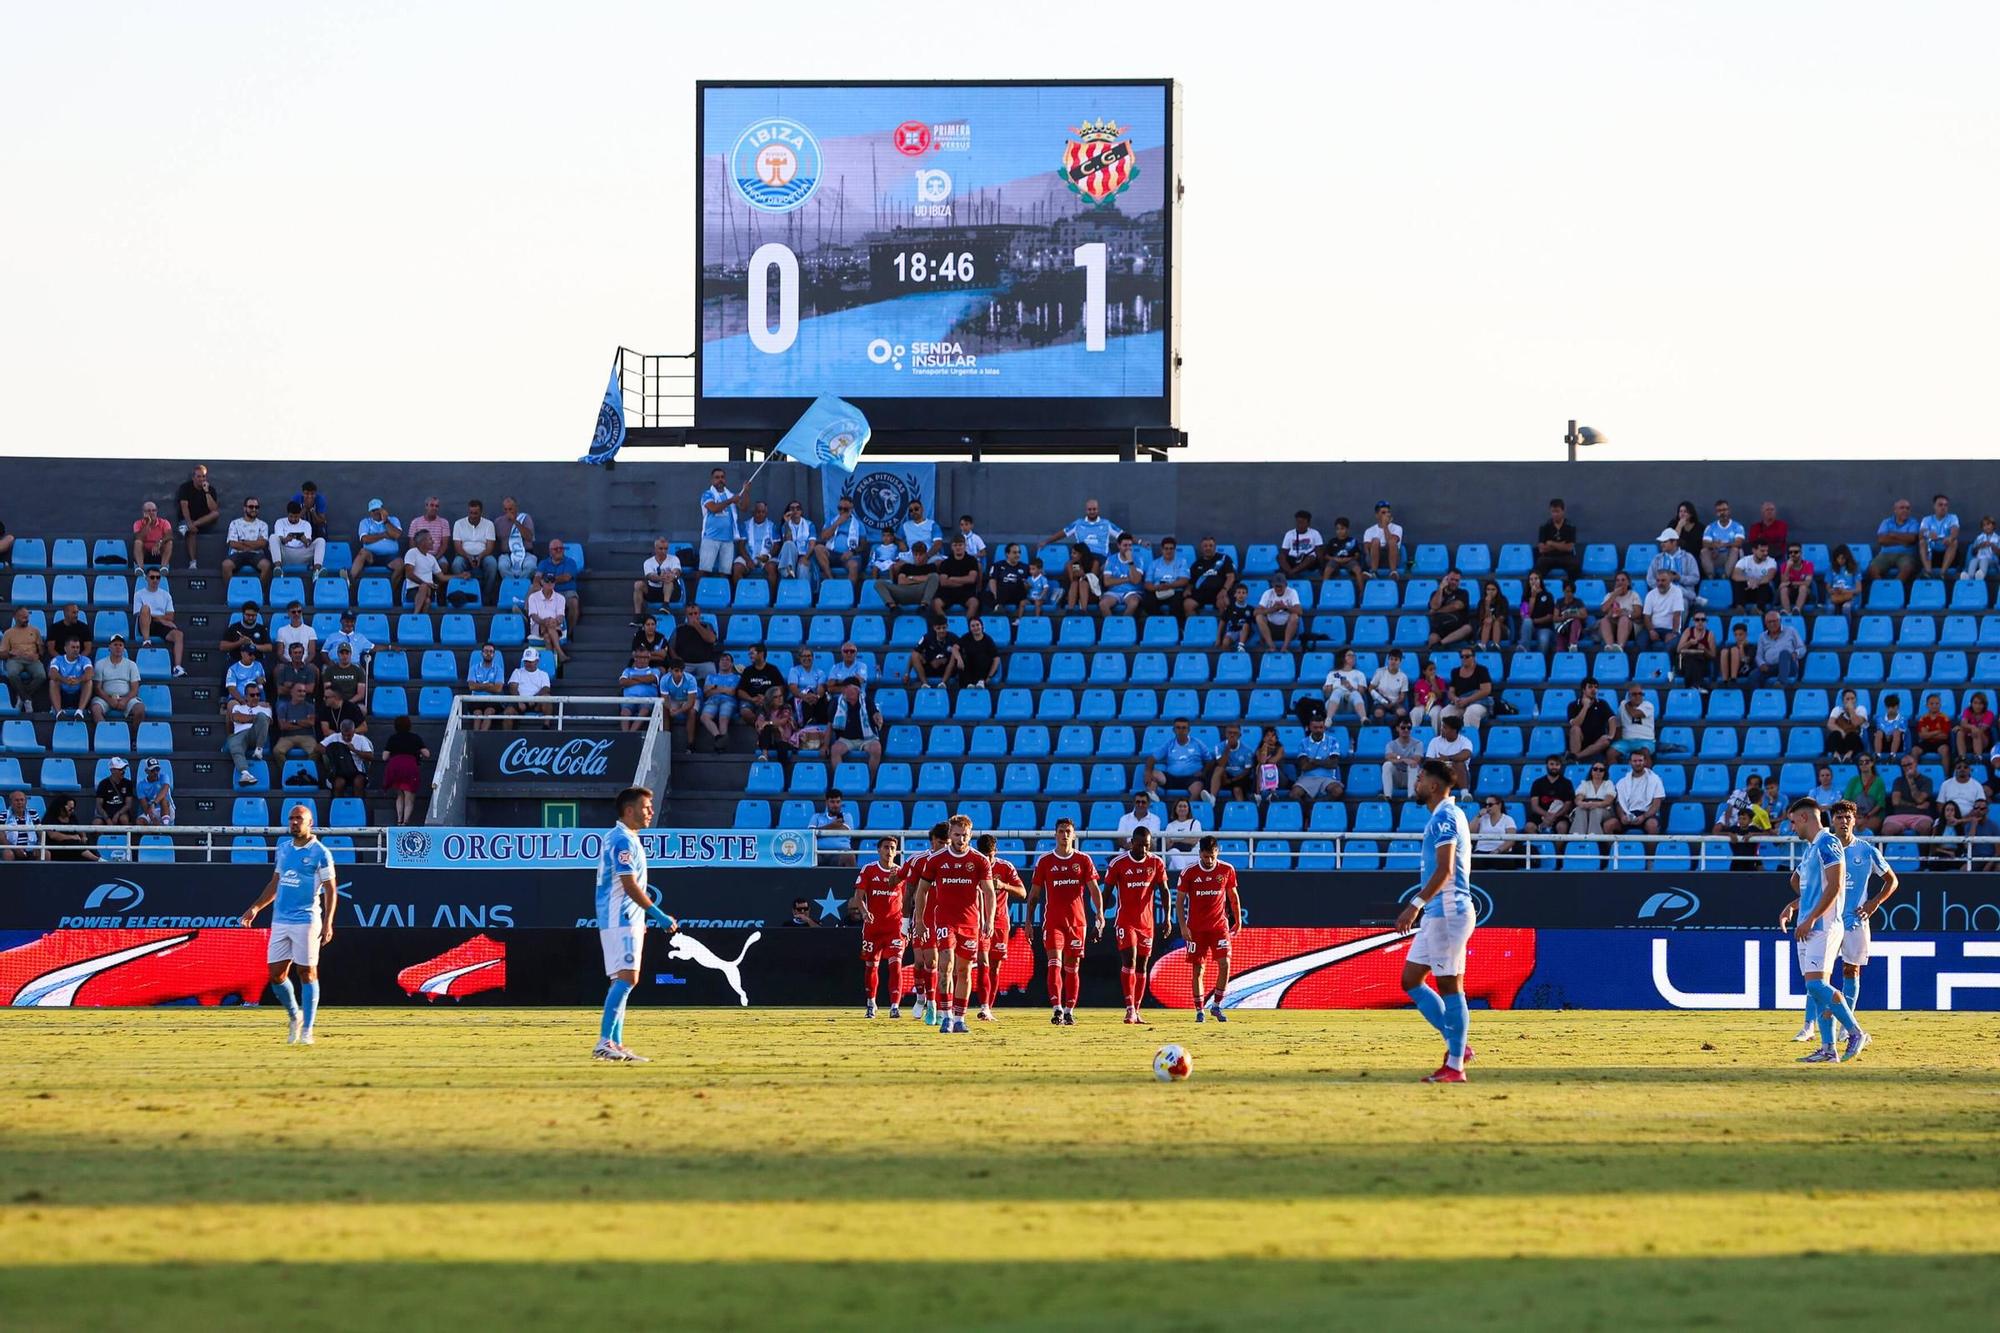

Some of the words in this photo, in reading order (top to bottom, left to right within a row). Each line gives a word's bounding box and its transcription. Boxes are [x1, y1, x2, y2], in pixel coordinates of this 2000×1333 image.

[933, 124, 970, 137] PRIMERA
[749, 127, 804, 150] IBIZA
[914, 205, 928, 217] UD
[929, 205, 952, 217] IBIZA
[893, 252, 975, 282] 18:46
[748, 242, 799, 354] 0
[1074, 242, 1106, 352] 1
[911, 342, 963, 355] SENDA
[911, 355, 977, 367] INSULAR
[911, 368, 949, 376] Transporte
[950, 368, 978, 376] Urgente
[500, 738, 615, 775] Coca-Cola
[443, 834, 602, 860] ORGULLO
[638, 836, 757, 860] ELESTE
[58, 916, 123, 928] POWER
[125, 916, 243, 928] ELECTRONICS
[936, 927, 948, 940] 20
[862, 940, 874, 952] 23
